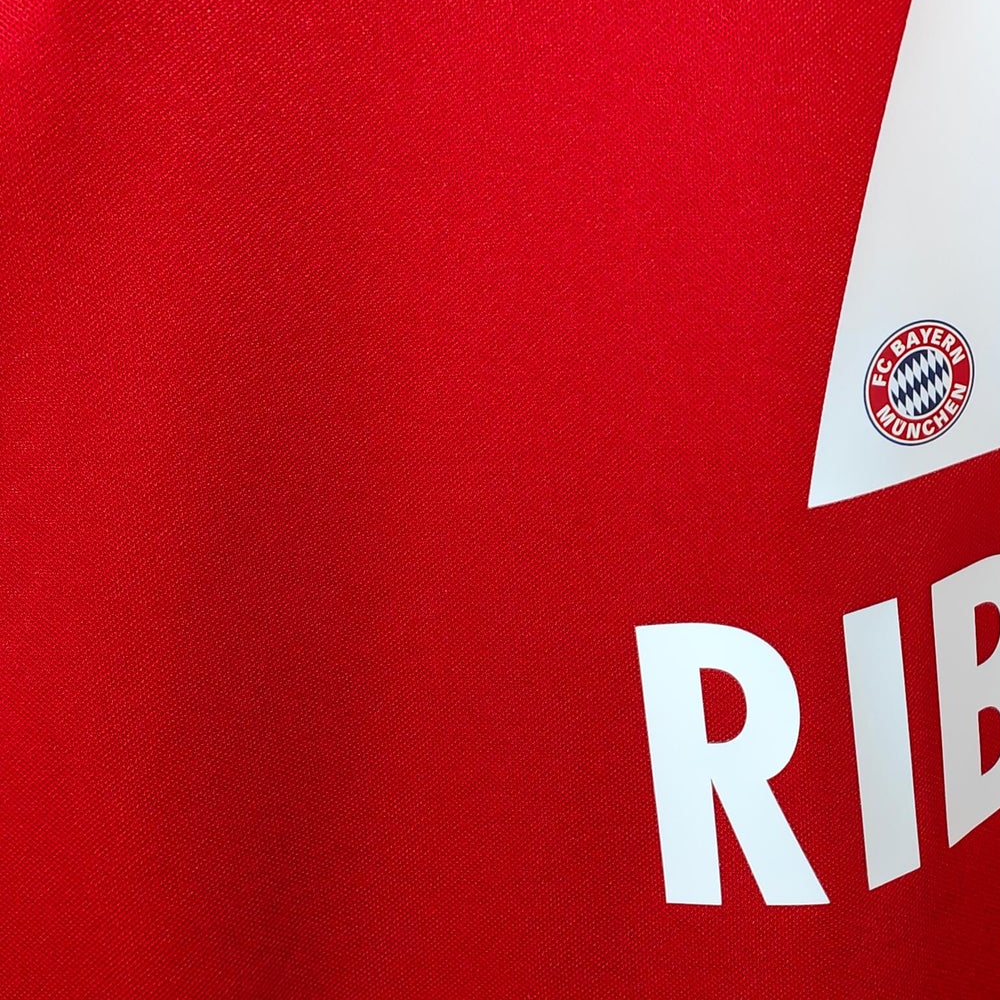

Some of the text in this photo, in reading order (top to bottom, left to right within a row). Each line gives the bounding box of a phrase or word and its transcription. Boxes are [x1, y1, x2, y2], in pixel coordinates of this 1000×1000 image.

[871, 327, 966, 387] FC BAYERN
[876, 383, 967, 439] MÜNCHEN
